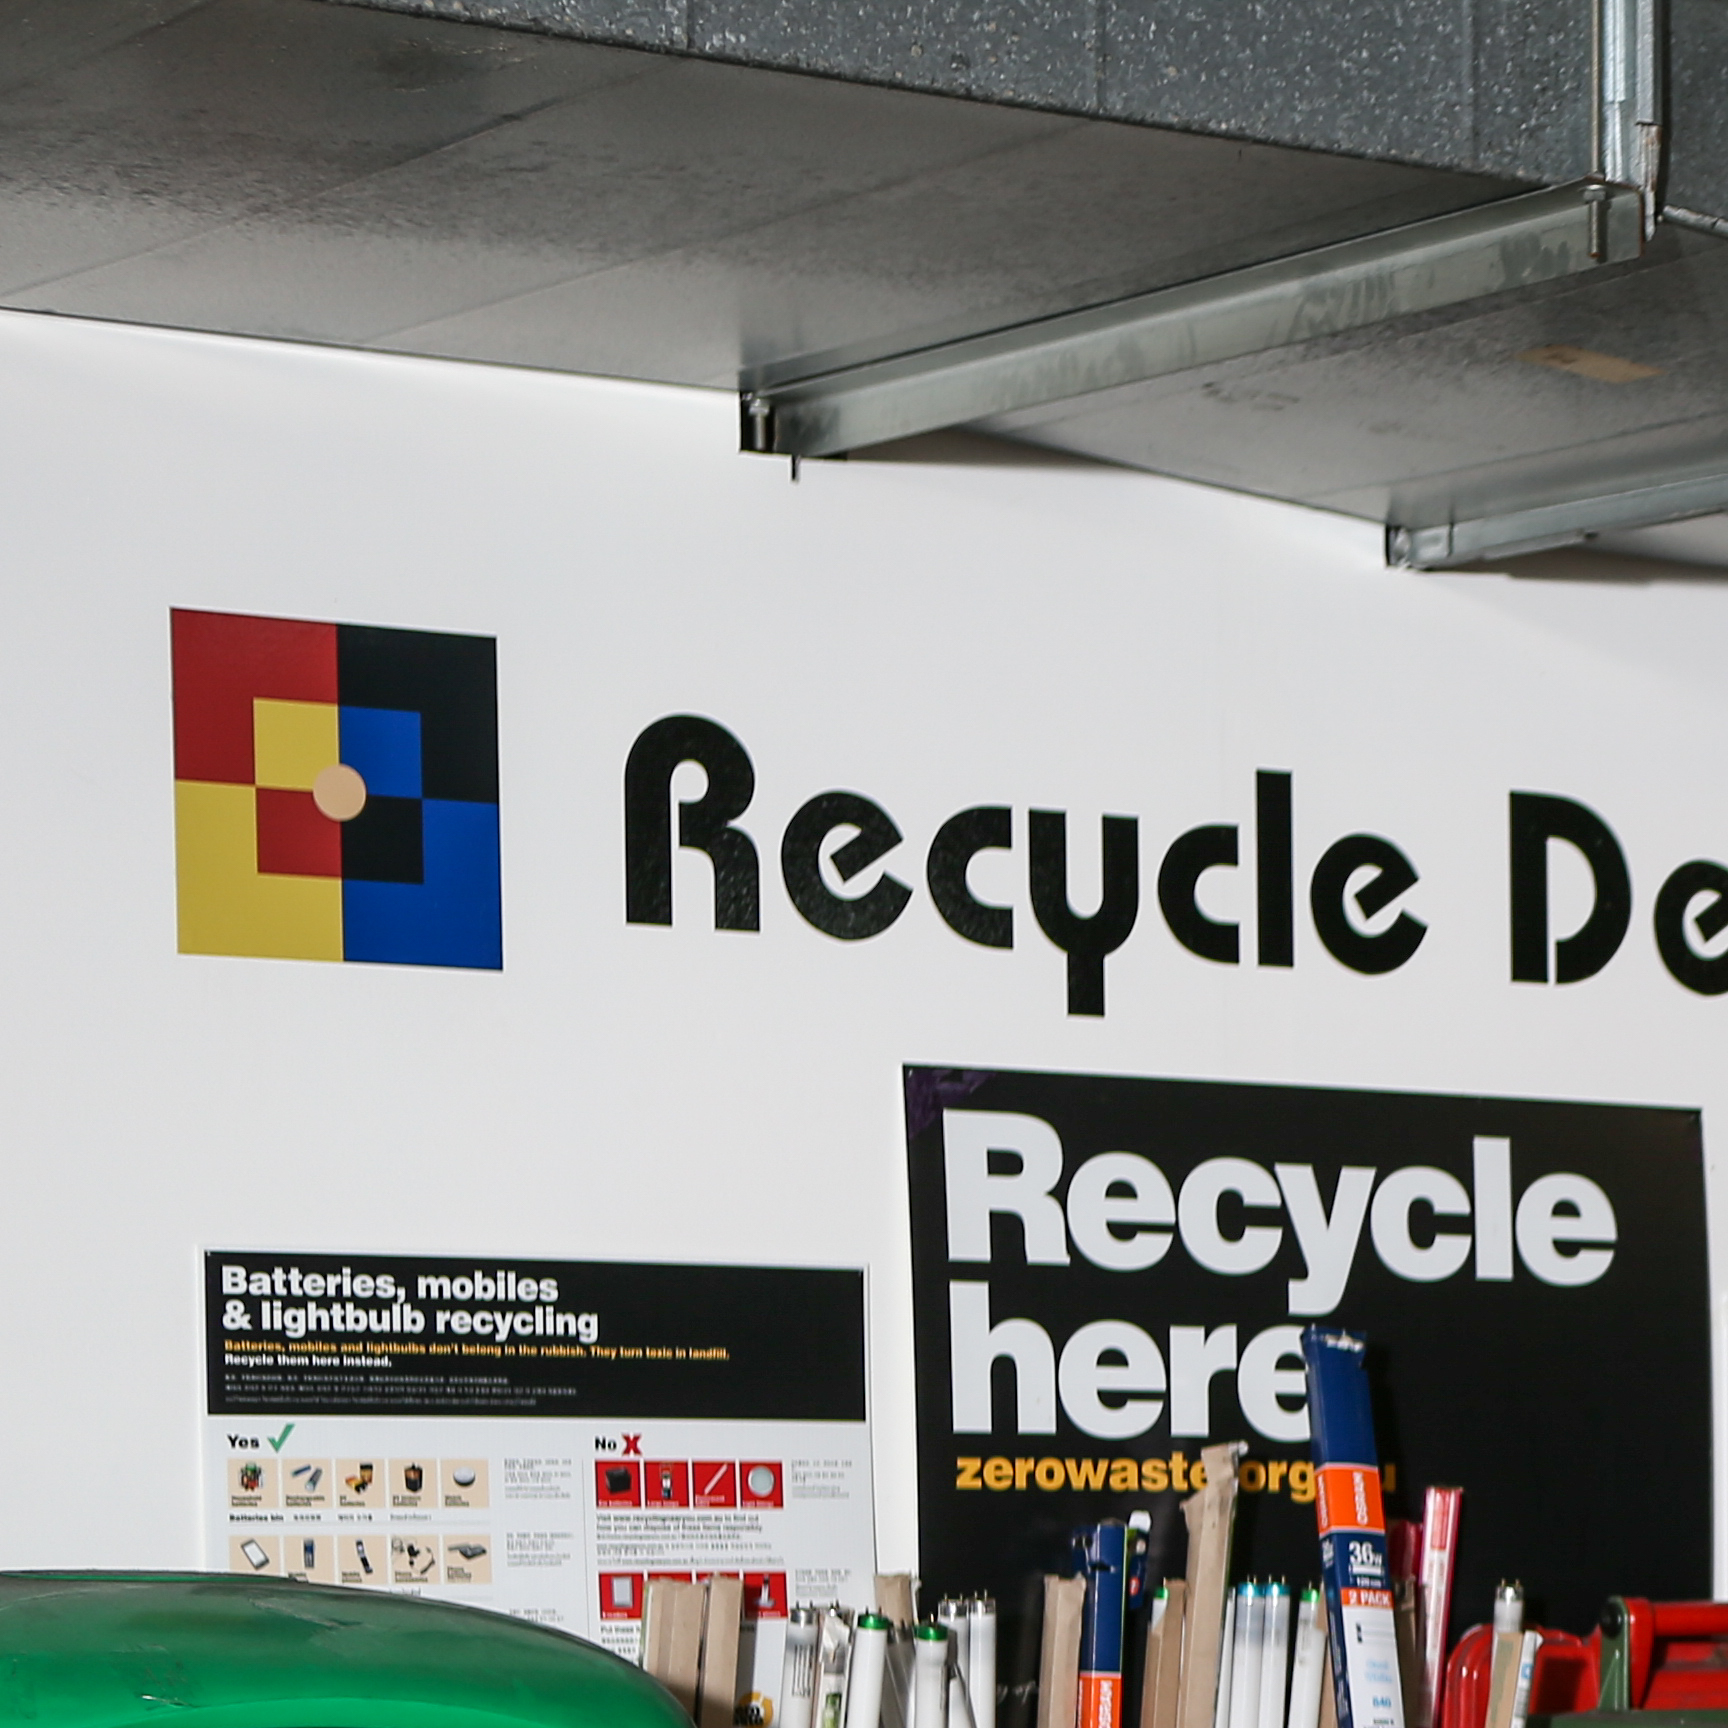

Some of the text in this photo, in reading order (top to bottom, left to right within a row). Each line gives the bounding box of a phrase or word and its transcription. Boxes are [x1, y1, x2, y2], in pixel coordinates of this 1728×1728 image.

[624, 711, 1429, 1017] Recycle
[942, 1107, 1618, 1316] Recycle
[222, 1265, 559, 1303] Batteries, mobiles
[222, 1299, 599, 1343] & lightbulb recycling
[224, 1353, 392, 1368] Recycle them here instead.
[948, 1279, 1311, 1441] here
[227, 1434, 260, 1449] Yes
[594, 1437, 617, 1451] No
